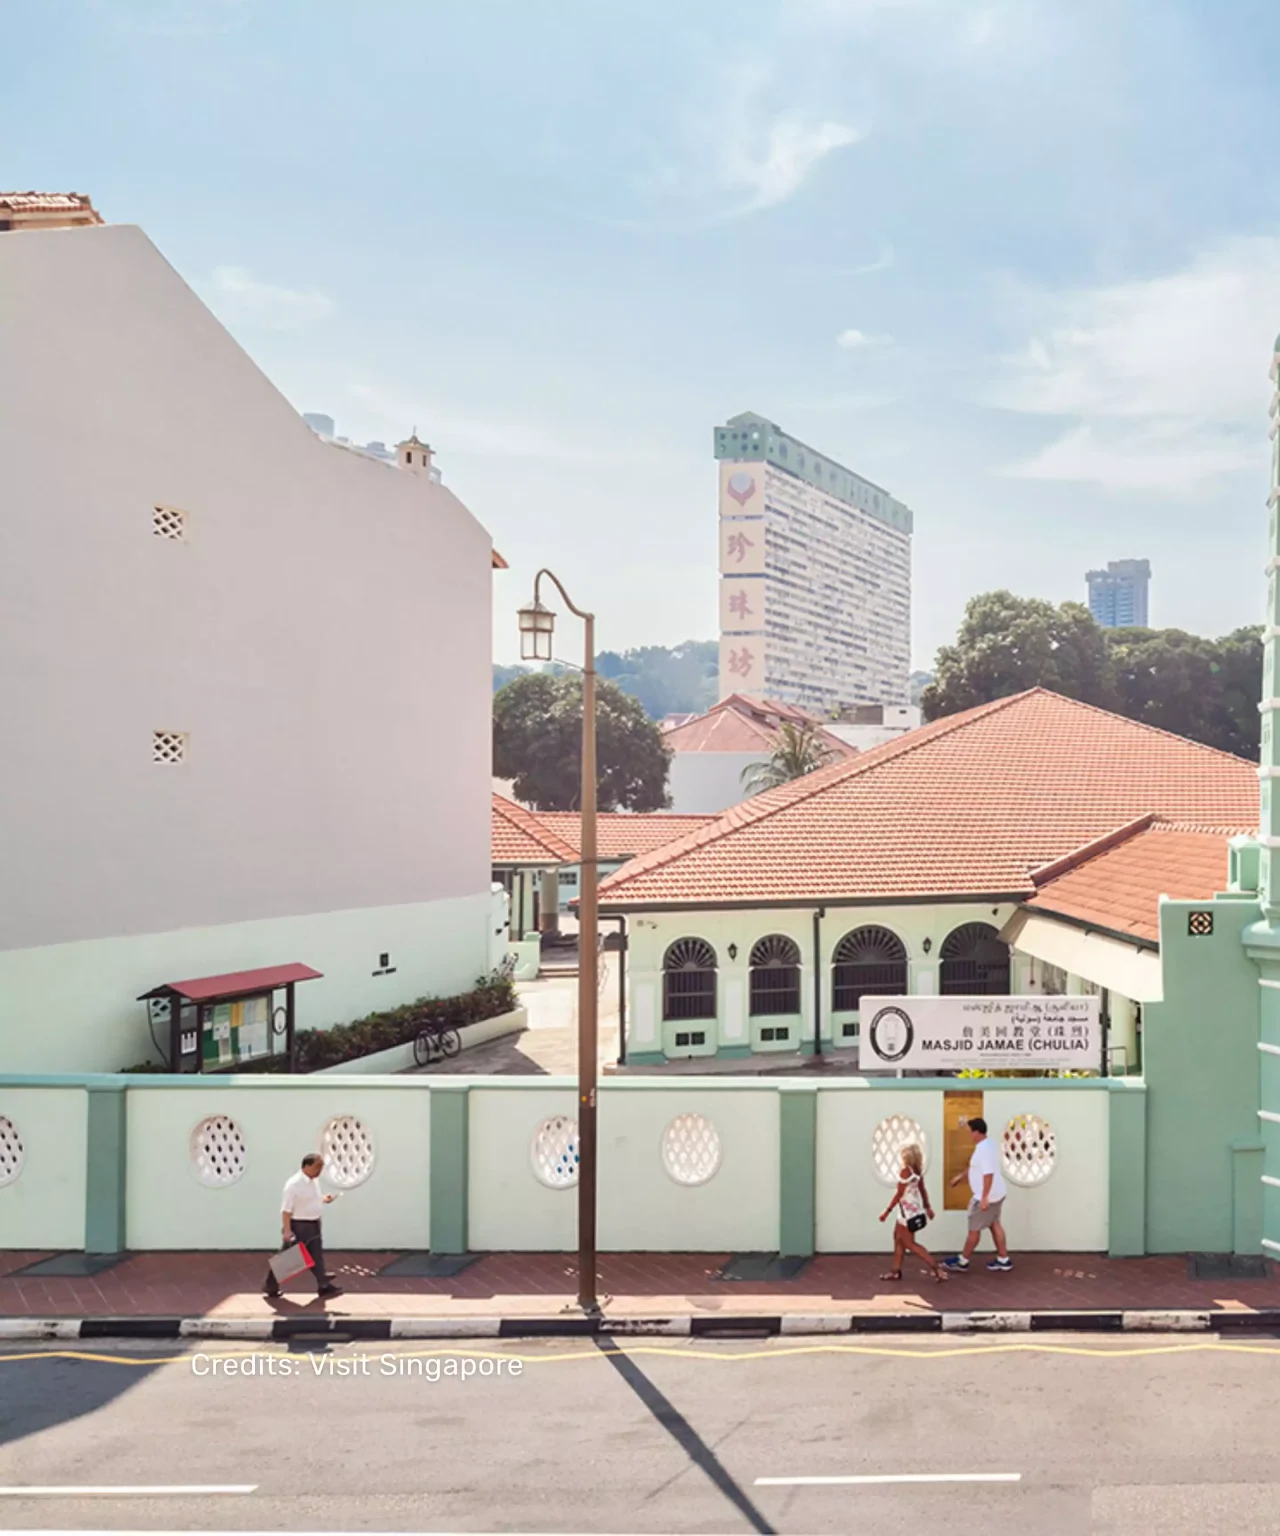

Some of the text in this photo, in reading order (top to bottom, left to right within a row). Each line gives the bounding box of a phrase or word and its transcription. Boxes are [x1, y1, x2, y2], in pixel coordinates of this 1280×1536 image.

[727, 531, 755, 678] 珍珠坊
[921, 1038, 1089, 1051] MASJID JAMAE (CHULIA)
